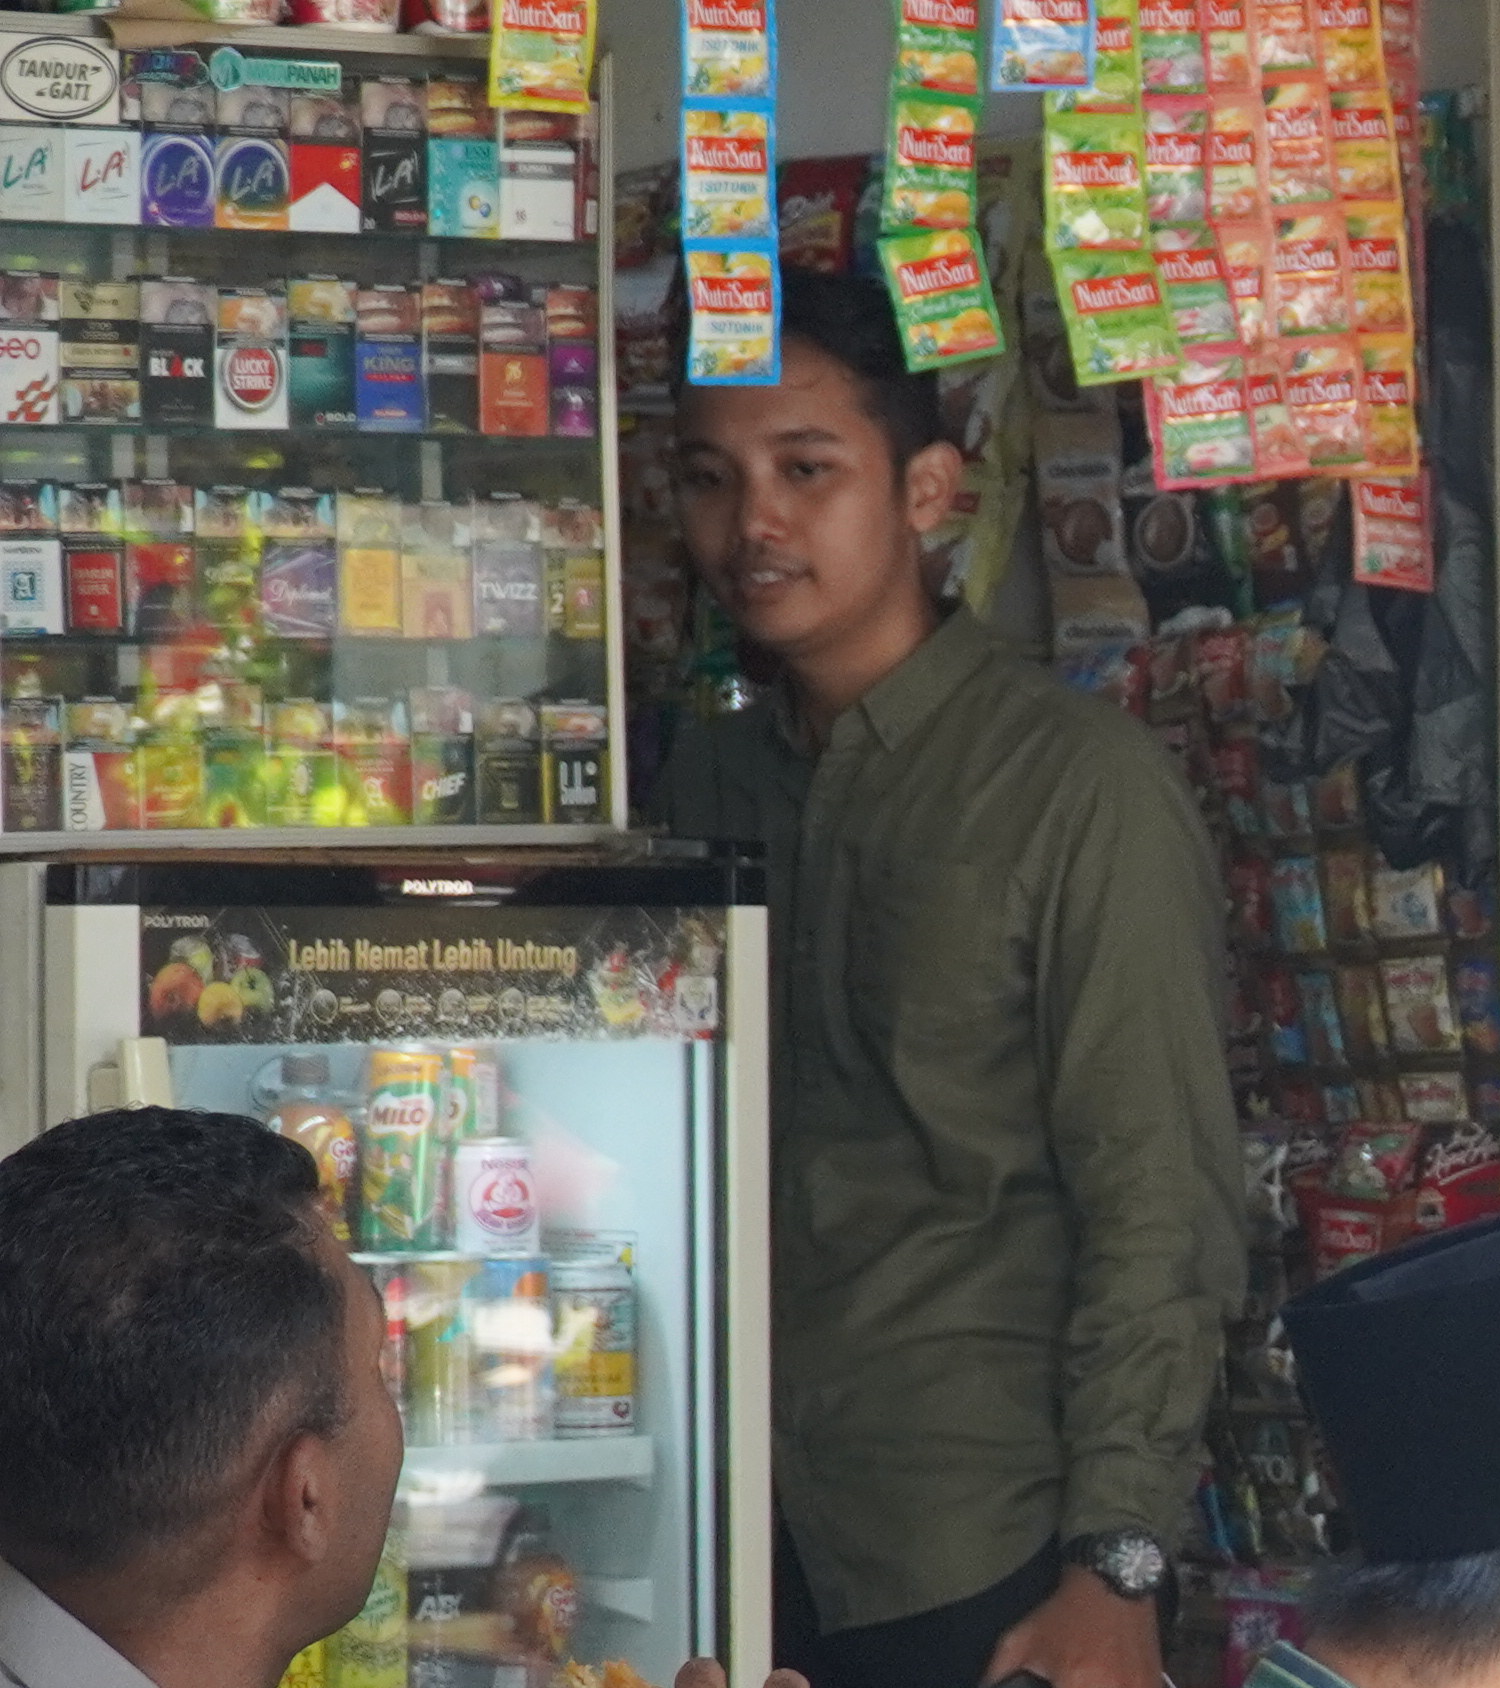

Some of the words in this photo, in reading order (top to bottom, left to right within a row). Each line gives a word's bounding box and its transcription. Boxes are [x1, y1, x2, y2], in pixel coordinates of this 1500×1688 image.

[18, 59, 88, 78] TANDUR
[50, 82, 92, 101] GATI
[691, 139, 763, 170] NutriSari
[900, 258, 974, 293] NutriSari
[697, 279, 767, 310] NutriSari
[1076, 279, 1157, 309] NutriSari
[235, 359, 271, 375] LUCKY
[234, 375, 274, 390] STRIKE
[479, 581, 539, 601] TWIZZ
[421, 771, 468, 801] CHIEF
[290, 938, 351, 972] Lebih
[432, 938, 494, 972] Lebih
[498, 938, 578, 979] Untung
[373, 1104, 426, 1127] MILO
